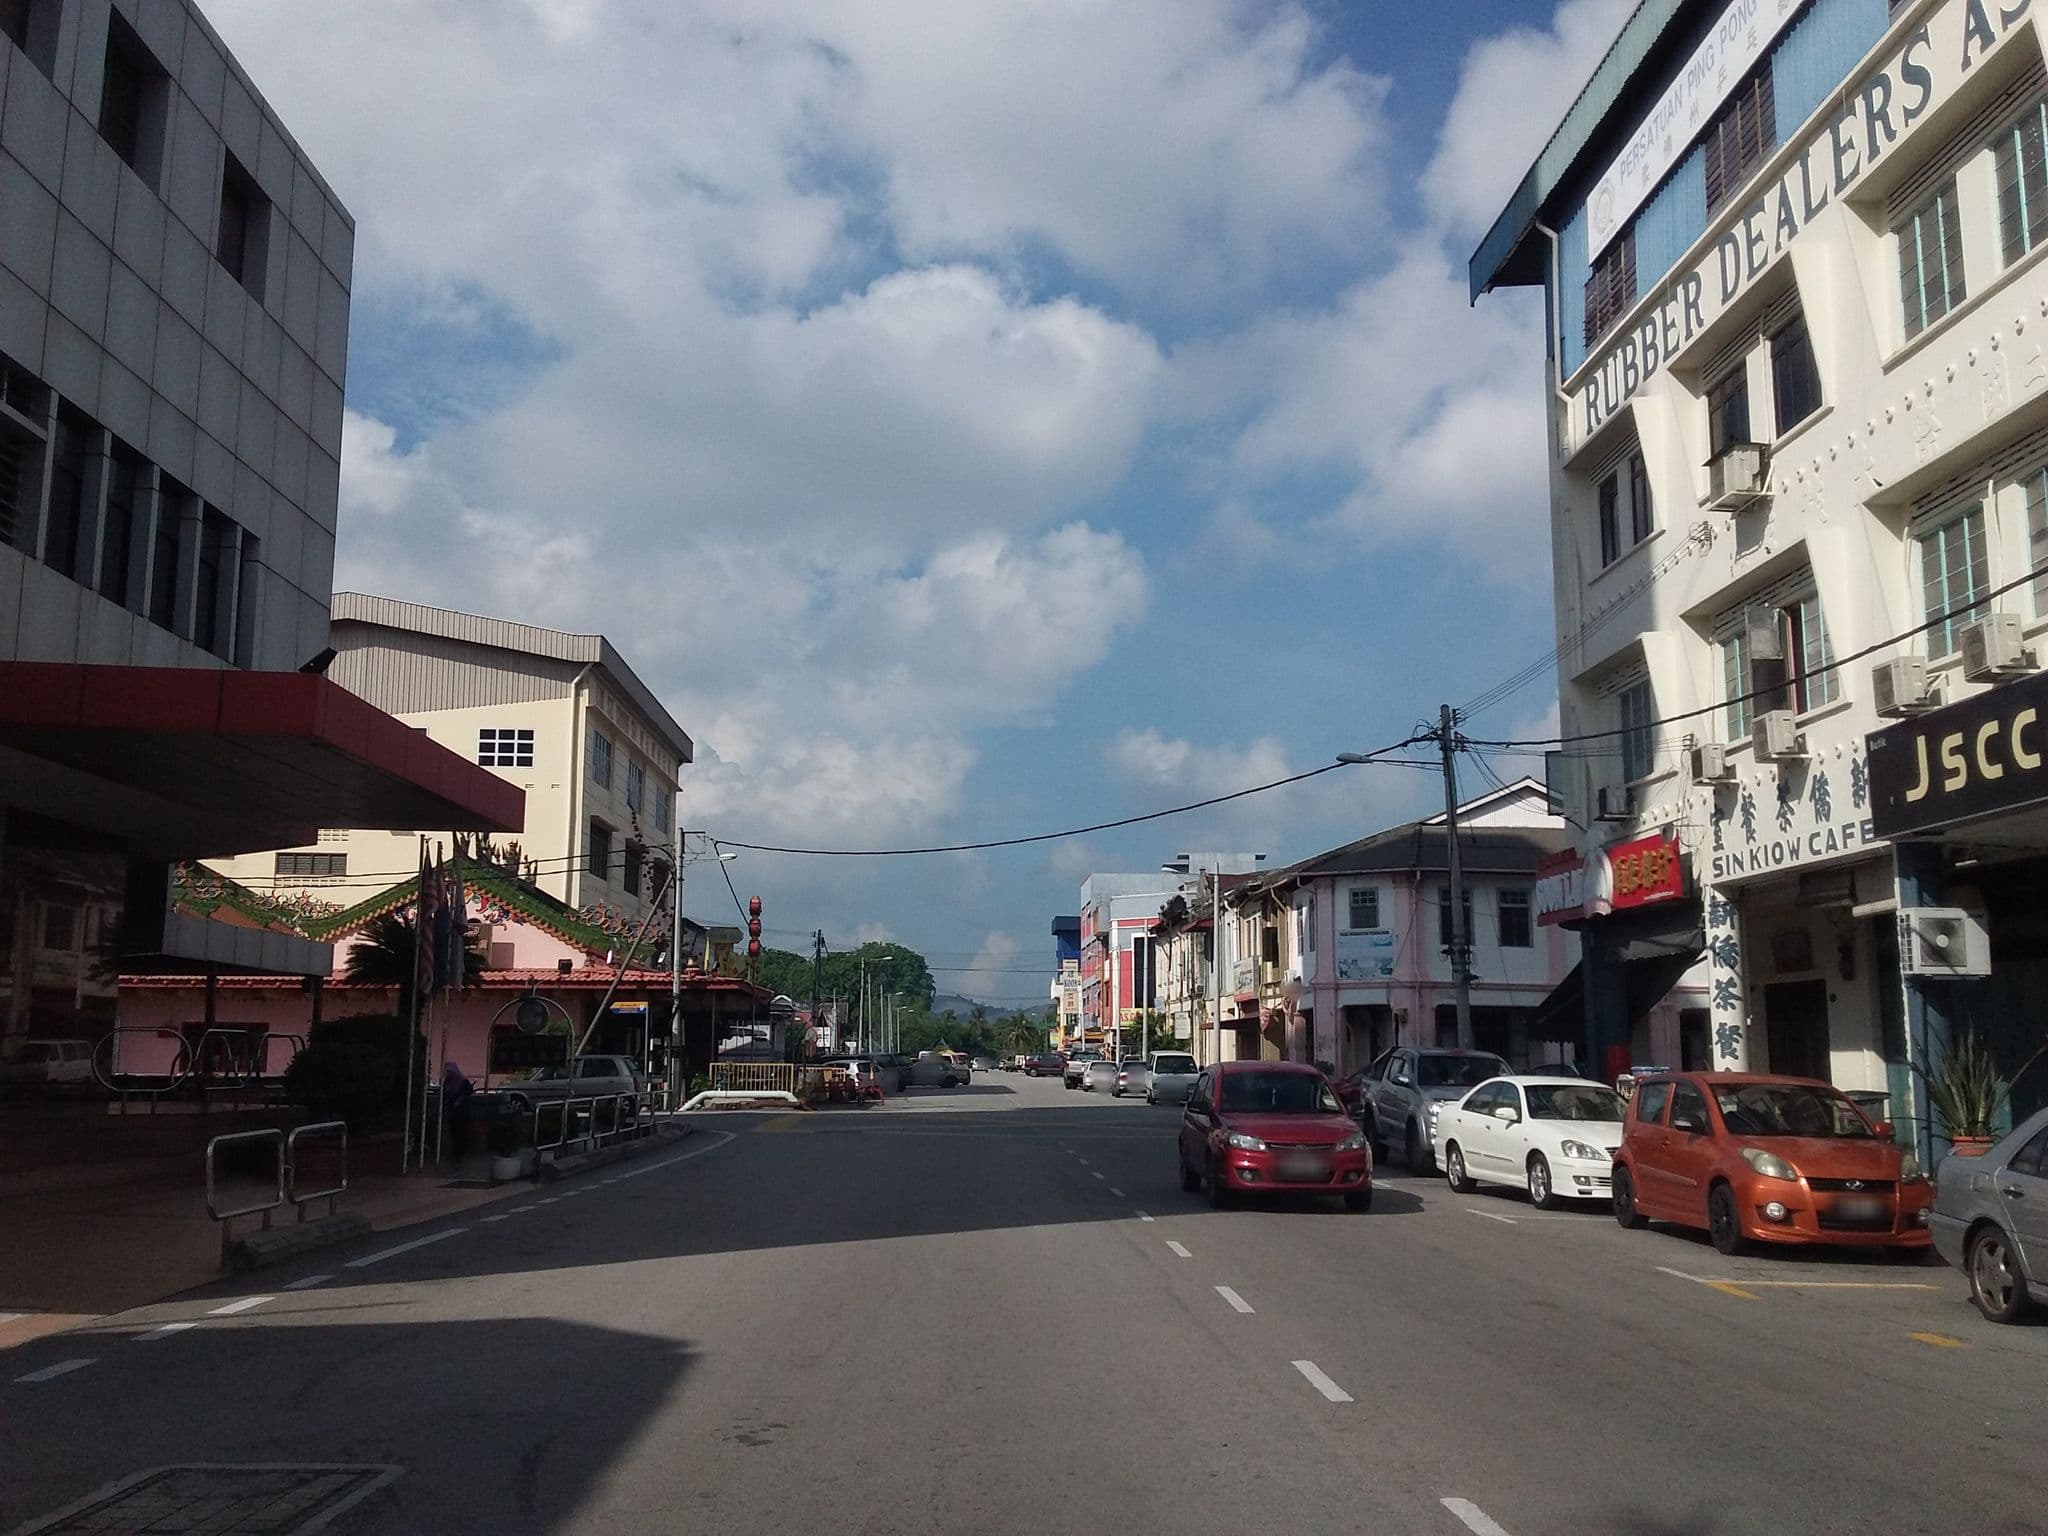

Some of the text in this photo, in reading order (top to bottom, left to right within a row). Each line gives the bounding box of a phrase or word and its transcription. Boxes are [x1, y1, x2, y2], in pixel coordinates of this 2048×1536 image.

[1618, 0, 1759, 185] PERSATUAN PING PONG
[1584, 270, 1705, 437] RUBBER
[1717, 25, 1932, 307] DEALERS
[1712, 850, 1746, 879] SIN
[1750, 836, 1801, 871] KIOW
[1808, 817, 1876, 857] CAFE
[1708, 896, 1743, 1072] 新僑茶餐
